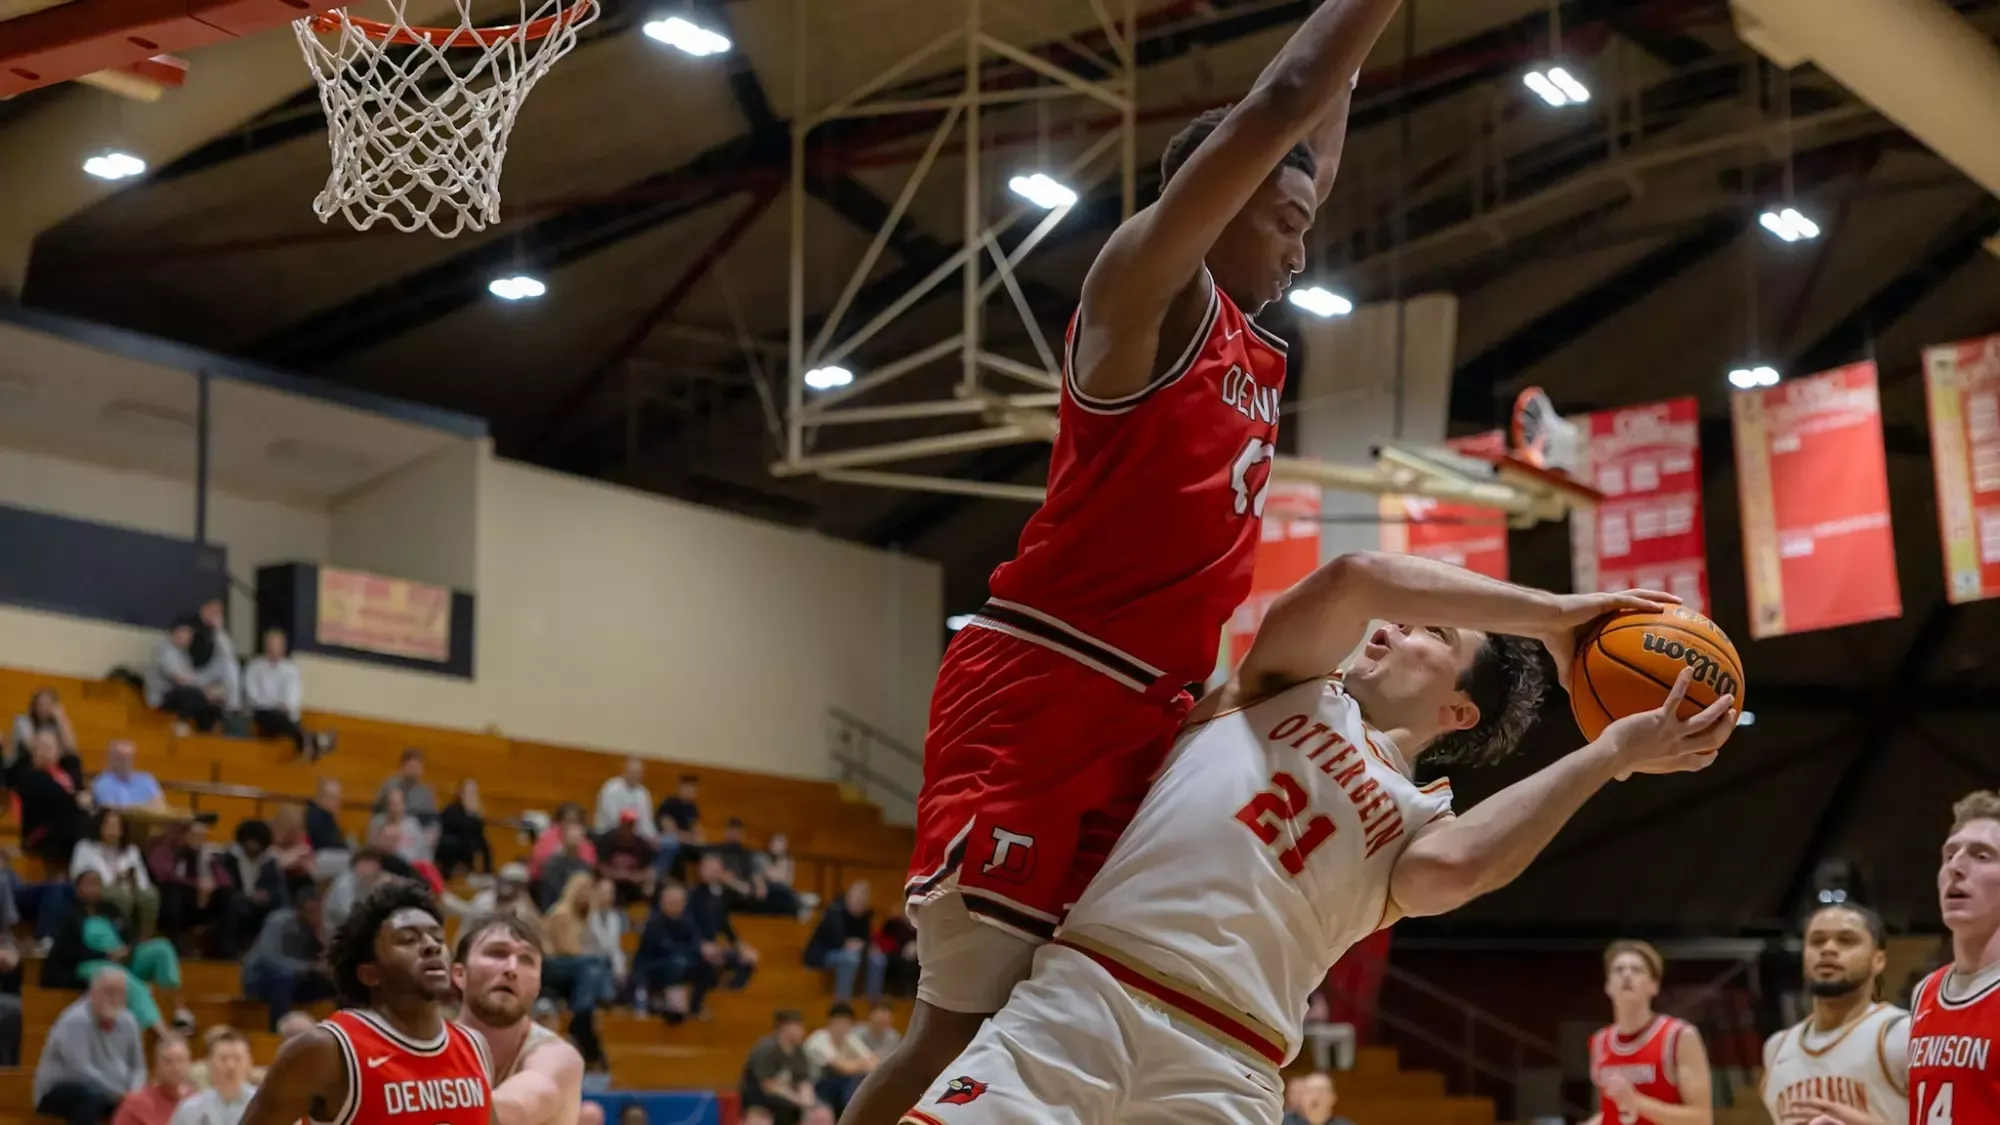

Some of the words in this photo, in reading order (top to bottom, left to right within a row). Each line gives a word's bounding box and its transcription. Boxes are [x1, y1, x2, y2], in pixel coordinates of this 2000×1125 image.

[1222, 364, 1280, 426] DENI
[1643, 632, 1738, 698] Wilson
[1267, 713, 1405, 860] OTTERBEIN
[1233, 771, 1337, 878] 21
[1908, 1035, 1992, 1071] DENISON
[383, 1077, 485, 1115] DENISON
[1915, 1080, 1954, 1125] 14
